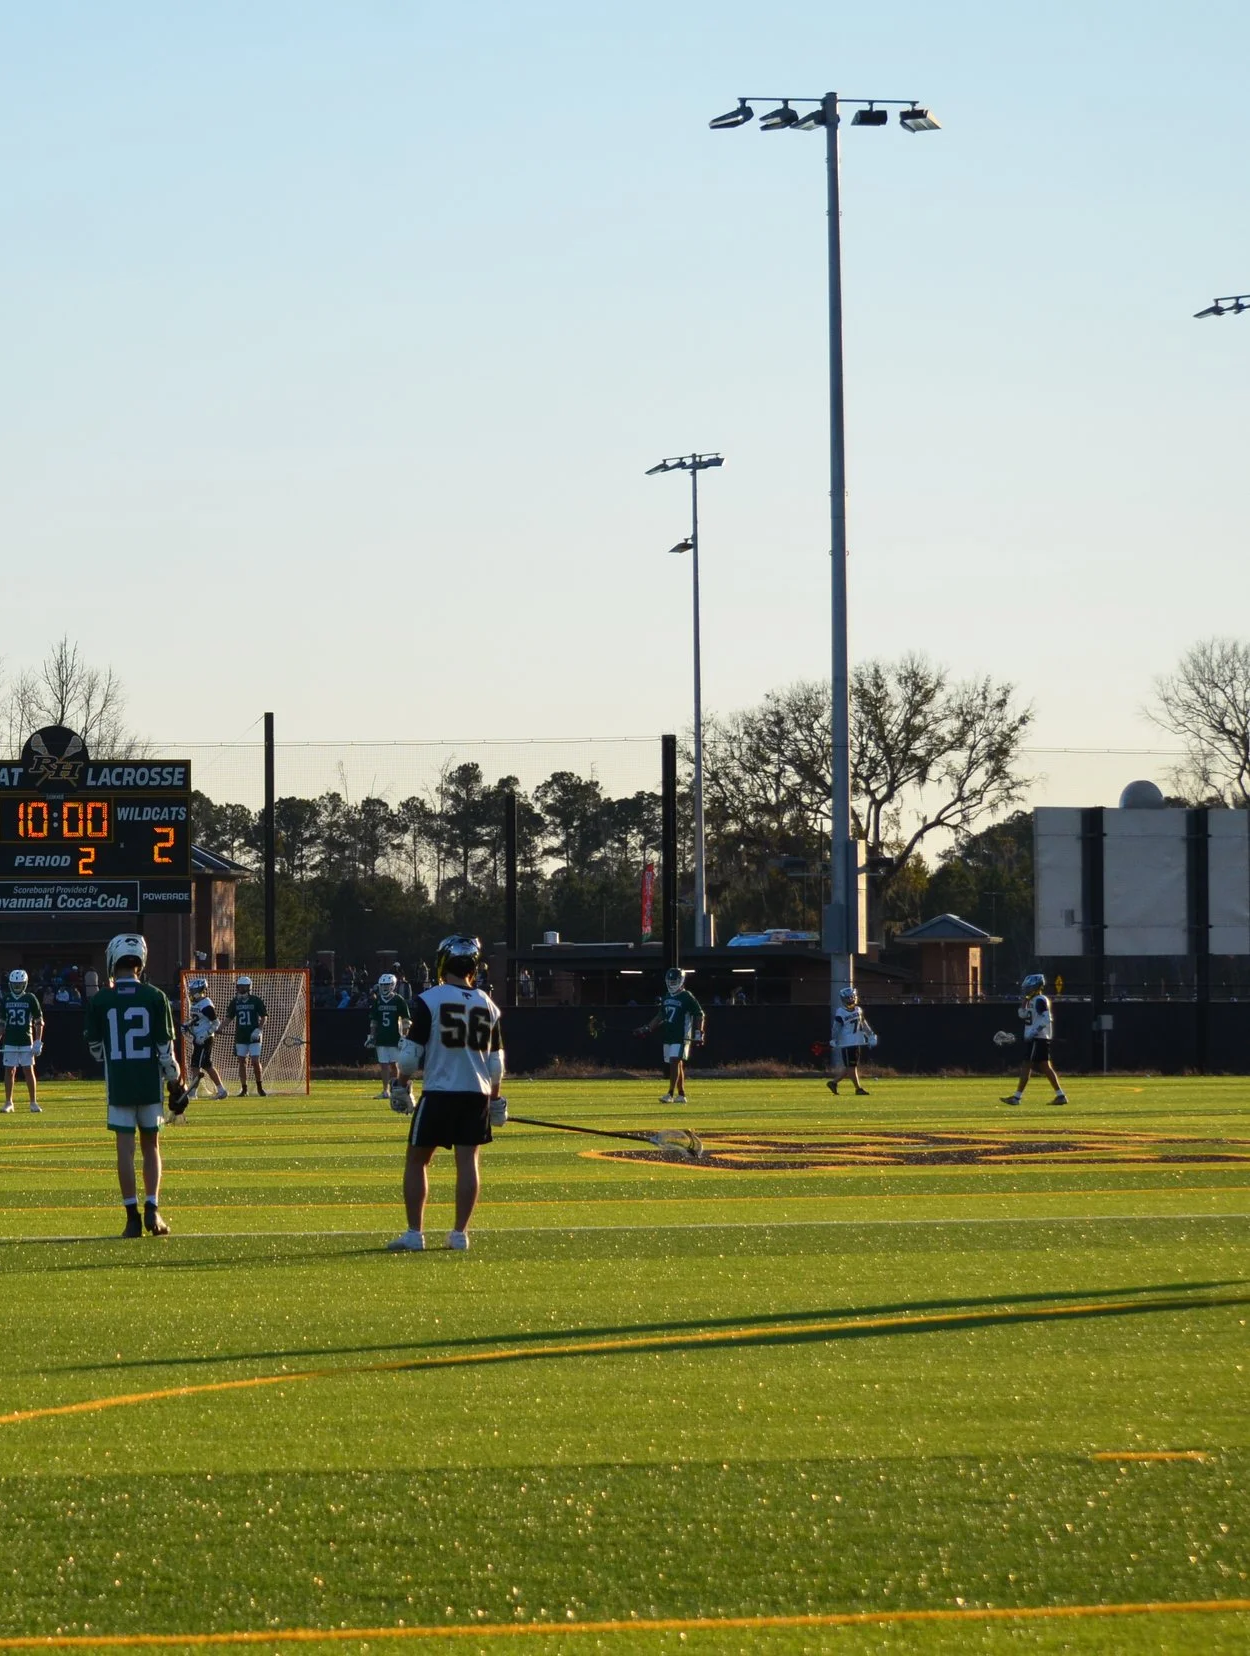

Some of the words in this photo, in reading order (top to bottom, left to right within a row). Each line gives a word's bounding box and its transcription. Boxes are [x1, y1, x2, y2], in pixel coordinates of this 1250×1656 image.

[29, 756, 84, 780] RH
[86, 767, 186, 787] LACROSSE
[18, 802, 108, 838] 10:00
[116, 806, 187, 821] WILDCATS
[153, 827, 175, 864] 2
[14, 855, 71, 868] PERIOD
[78, 847, 96, 875] 2
[13, 886, 55, 894] Scoreboard
[56, 886, 88, 894] Provided
[89, 886, 99, 895] By
[142, 893, 190, 901] POWERADE
[57, 894, 129, 909] Coca-Cola
[9, 1009, 26, 1026] 23
[239, 1011, 252, 1026] 21
[382, 1012, 391, 1027] 5
[106, 1006, 151, 1060] 12
[440, 1003, 491, 1052] 56
